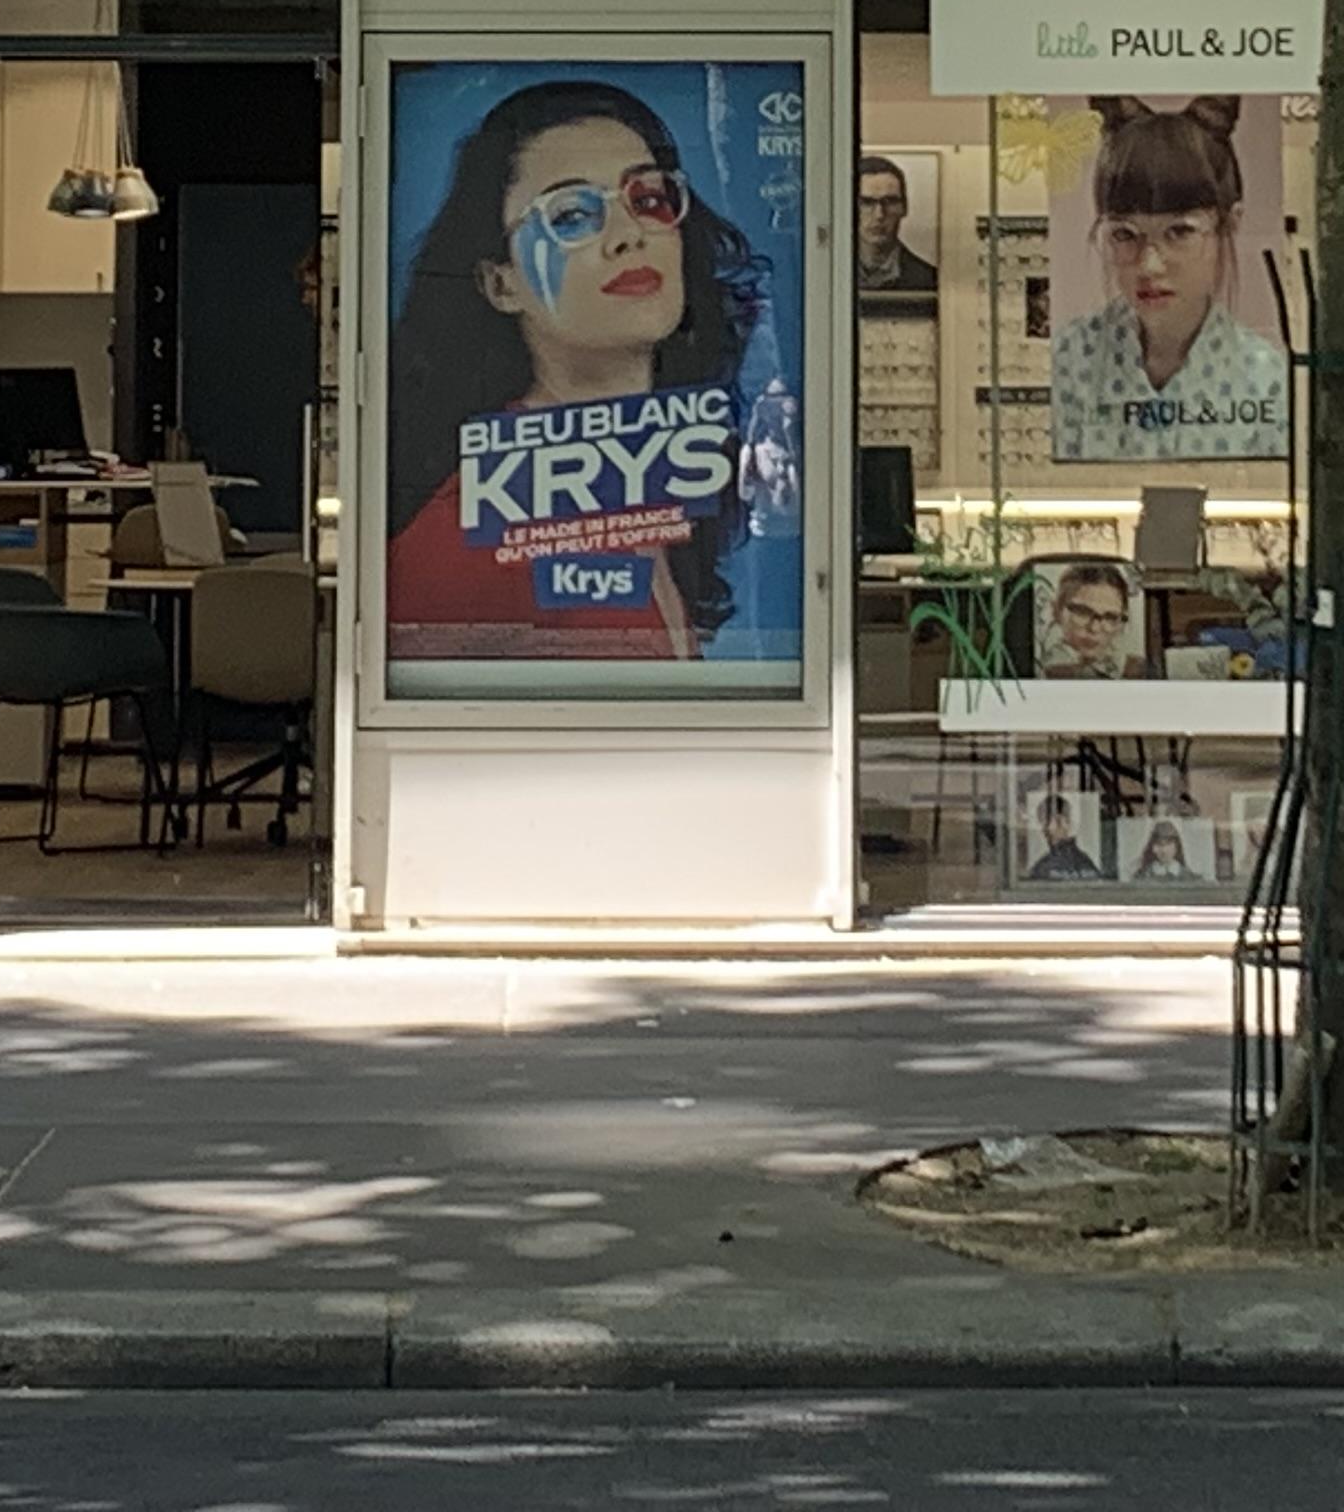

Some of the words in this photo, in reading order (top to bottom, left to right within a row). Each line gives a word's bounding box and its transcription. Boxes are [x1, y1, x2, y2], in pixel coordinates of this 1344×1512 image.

[1111, 29, 1195, 57] PAUL
[1232, 28, 1295, 57] JOE
[460, 411, 575, 456] BLEU
[582, 389, 731, 438] BLANC
[1223, 399, 1276, 424] JOE
[460, 425, 733, 529] KRYS
[503, 528, 527, 545] LE
[530, 521, 583, 540] MADE
[586, 516, 605, 533] IN
[608, 505, 684, 530] FRANCE
[556, 534, 604, 554] PEUT
[552, 563, 634, 600] Krys
